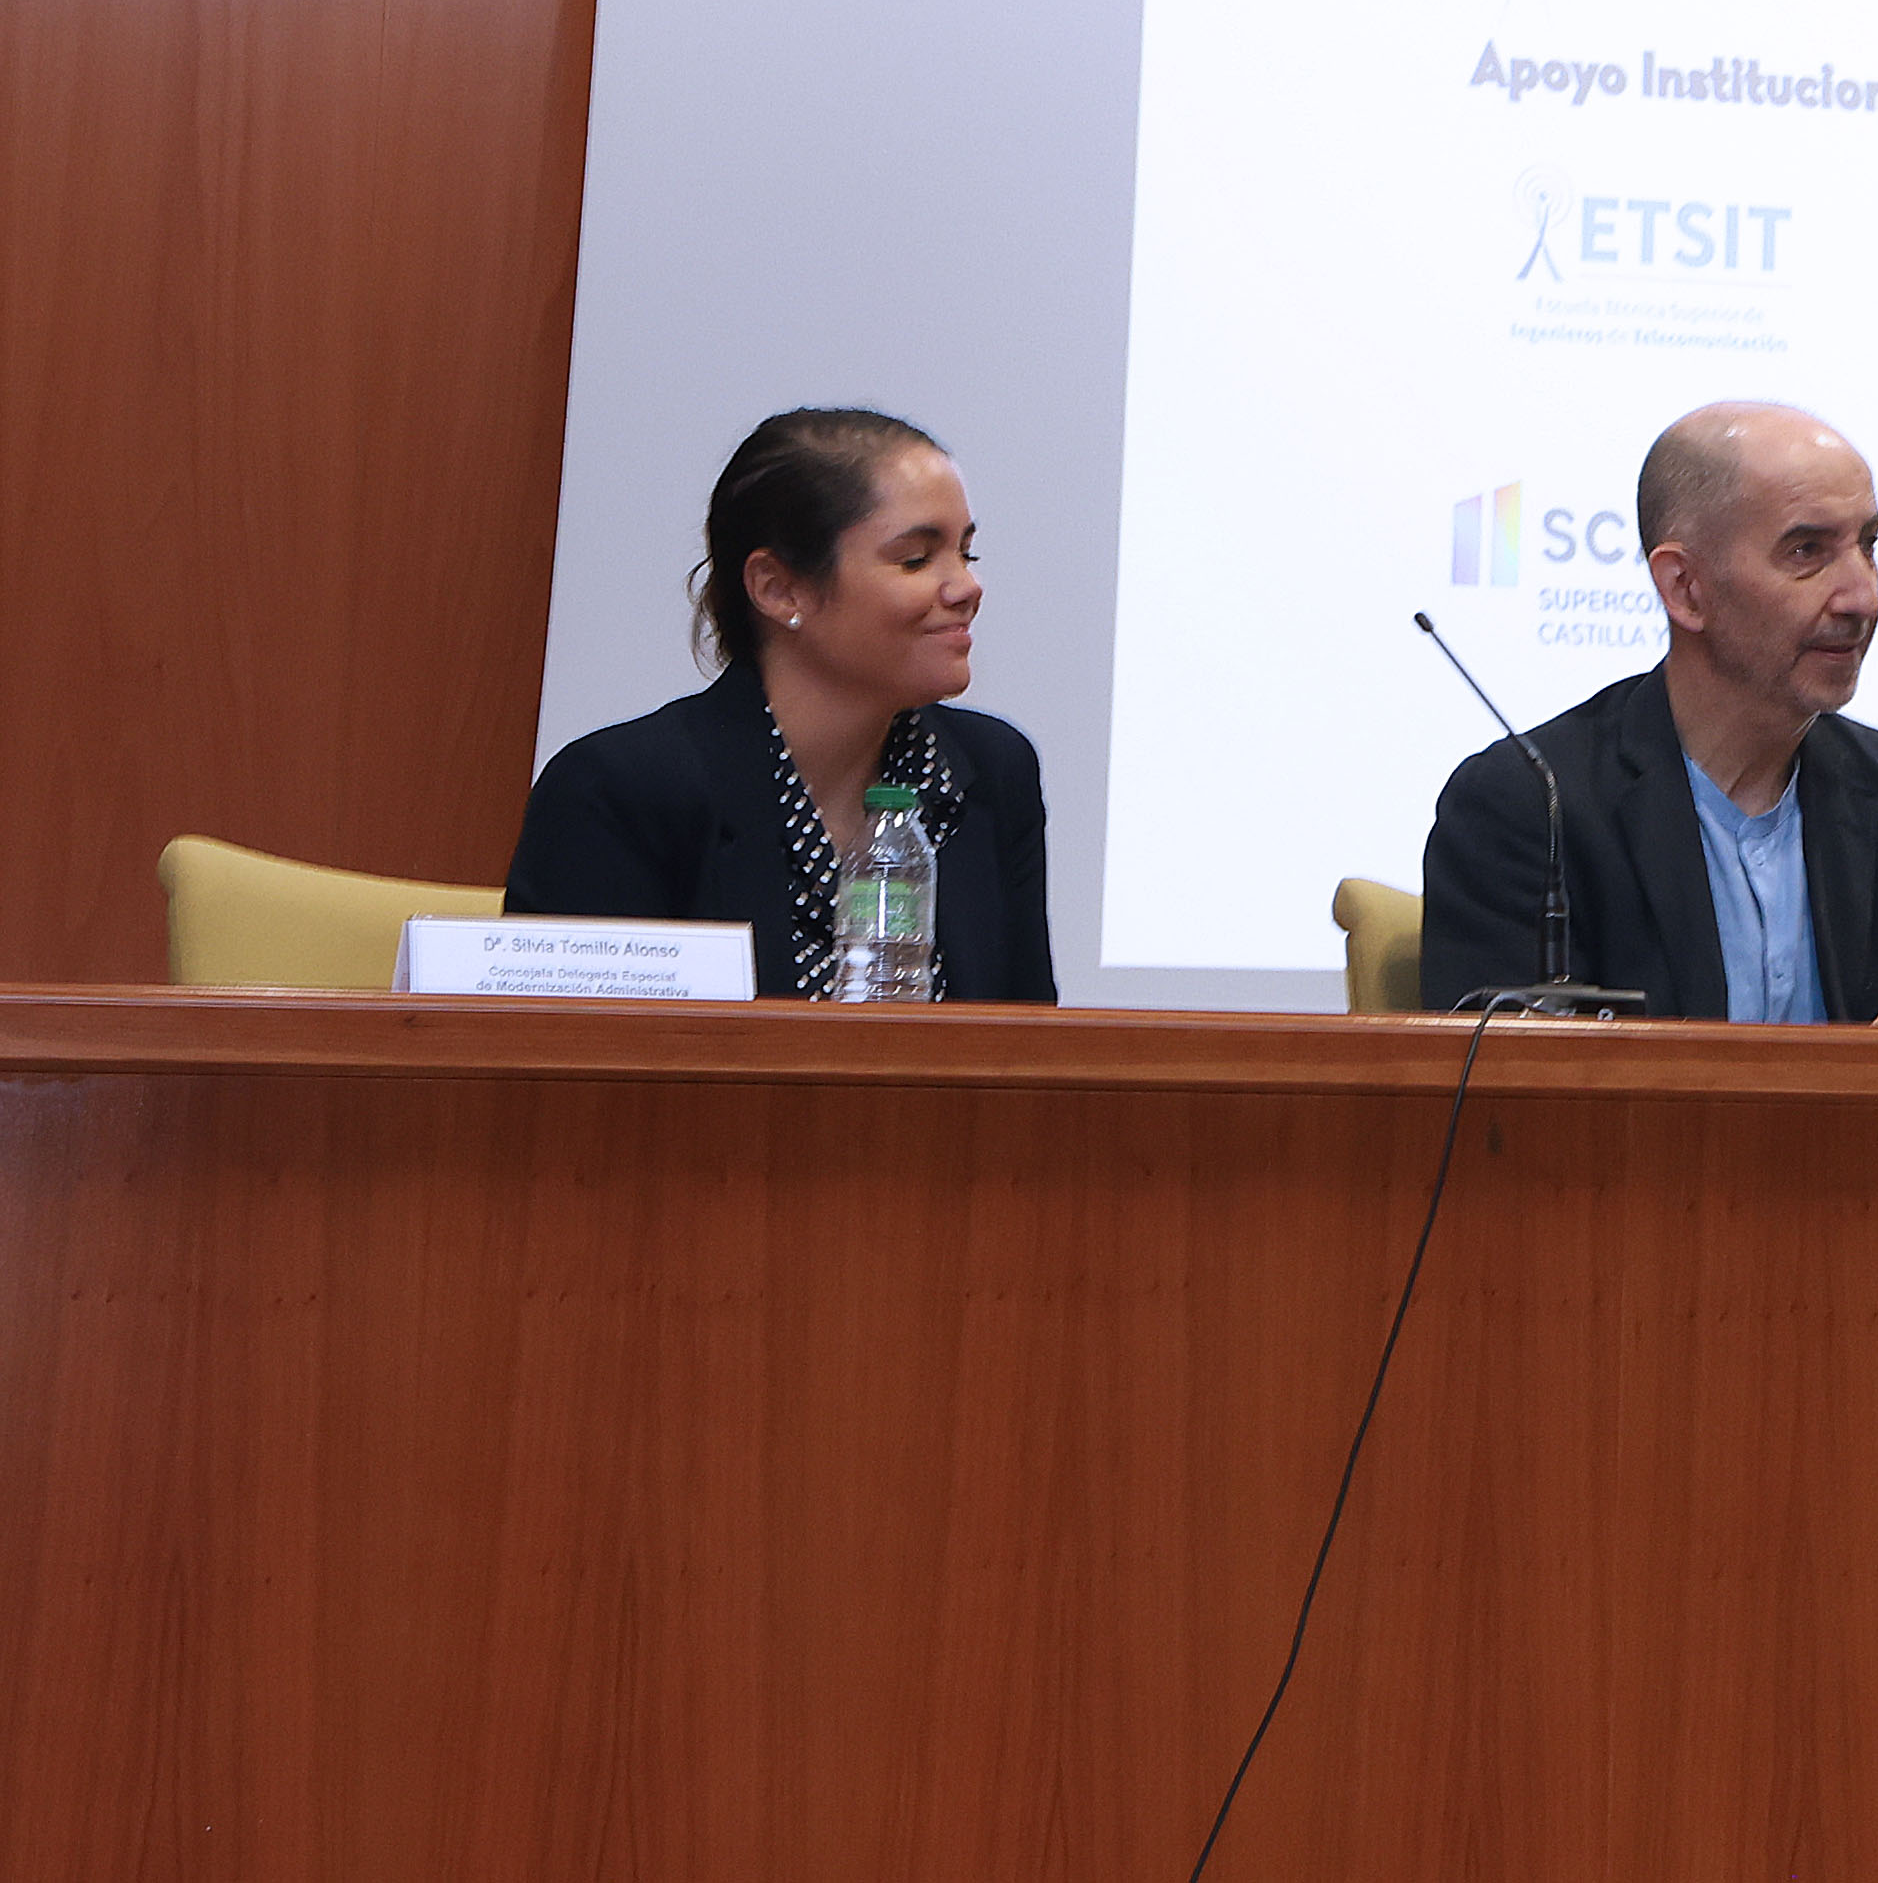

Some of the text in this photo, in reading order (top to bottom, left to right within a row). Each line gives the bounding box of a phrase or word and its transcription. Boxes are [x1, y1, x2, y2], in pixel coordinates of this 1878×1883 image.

[1470, 40, 1627, 105] Apoyo
[1580, 196, 1792, 273] ETSIT
[1537, 621, 1646, 647] CASTILLA
[512, 938, 554, 955] Silvia
[560, 939, 620, 957] Tomillo
[623, 942, 680, 959] Alonso
[623, 970, 677, 983] Especial
[476, 980, 690, 999] de Modernización Administrativa
